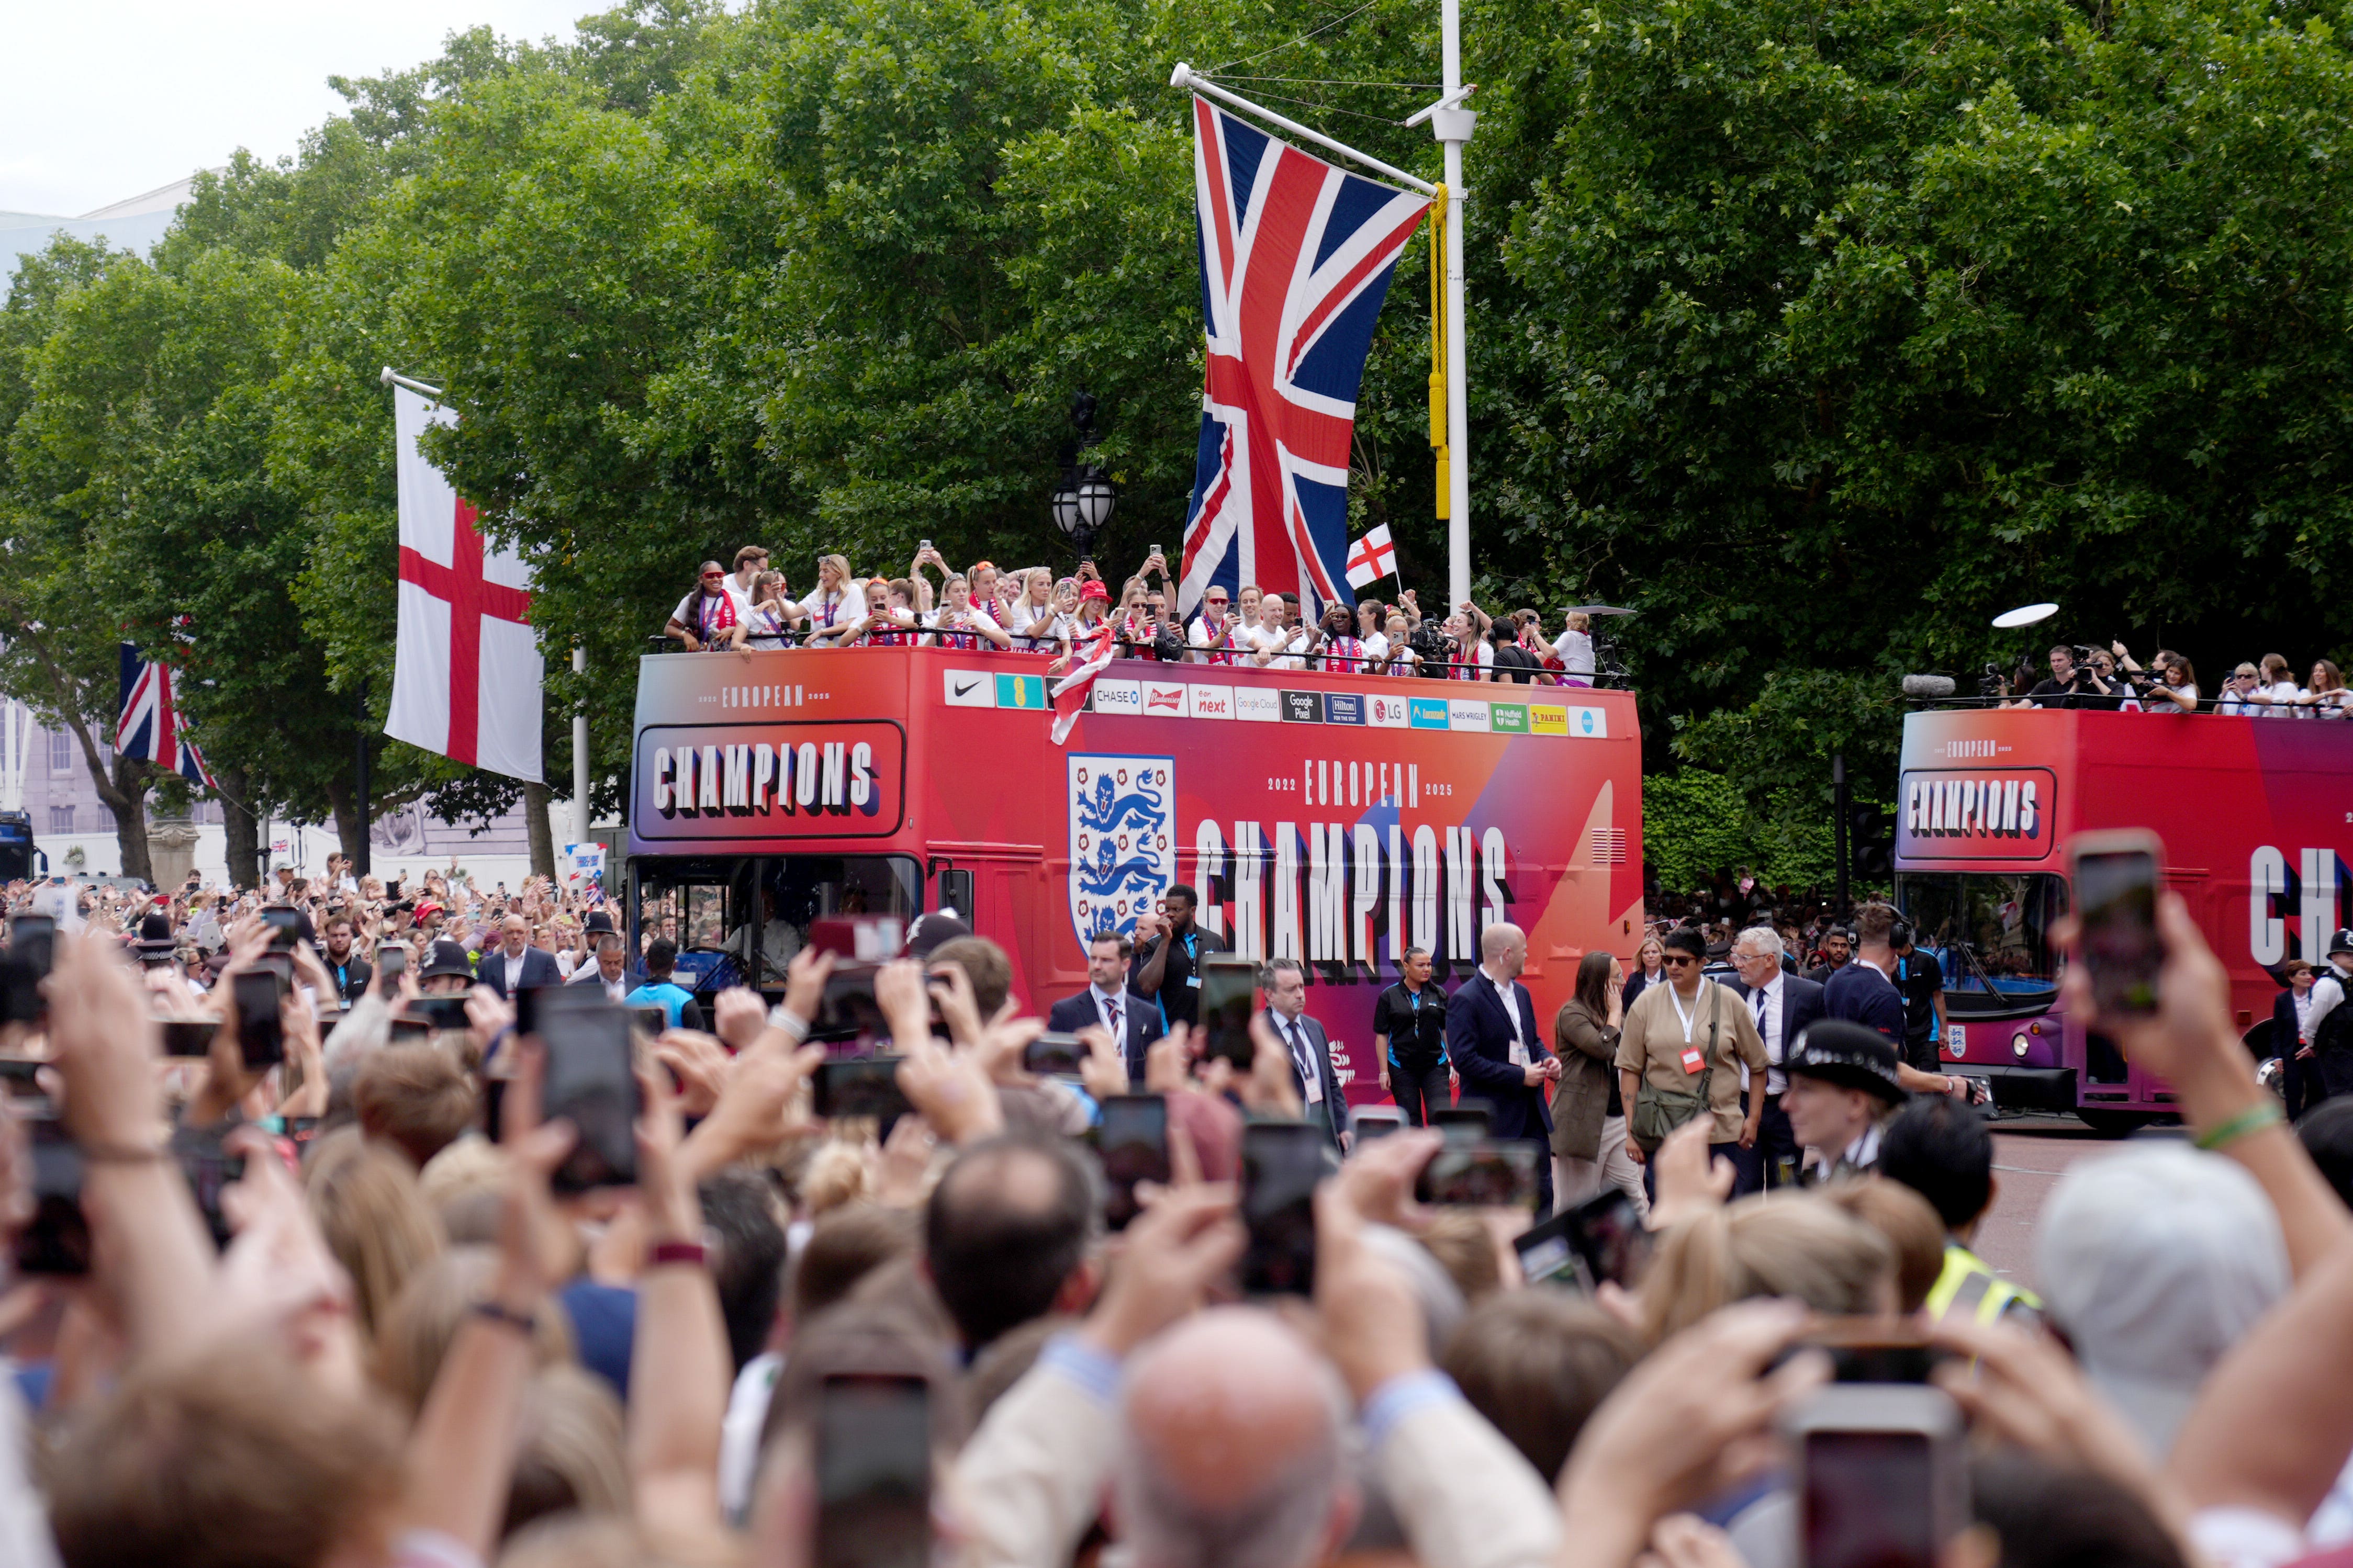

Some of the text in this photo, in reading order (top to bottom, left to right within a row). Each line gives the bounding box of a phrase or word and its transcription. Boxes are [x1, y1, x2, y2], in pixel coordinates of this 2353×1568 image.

[722, 684, 802, 708] EUROPEAN
[1097, 690, 1128, 703] CHASE
[1151, 693, 1180, 704] Budweiser
[1290, 694, 1313, 709] Google
[1198, 698, 1226, 714] next
[1238, 697, 1277, 710] Google Cloud
[1334, 700, 1354, 712] Hilton
[1295, 707, 1310, 719] Pixel
[1387, 704, 1401, 719] LG
[1466, 712, 1486, 720] WRIGLEY
[1504, 710, 1522, 718] Nuffield
[1540, 714, 1565, 722] PANINI
[1505, 718, 1520, 726] Health
[1947, 740, 1996, 758] EUROPEAN
[653, 741, 872, 810] CHAMPIONS
[1268, 760, 1452, 808] 2022 EUROPEAN 2025
[1908, 780, 2037, 832] CHAMPIONS
[1194, 818, 1506, 962] CHAMPIONS
